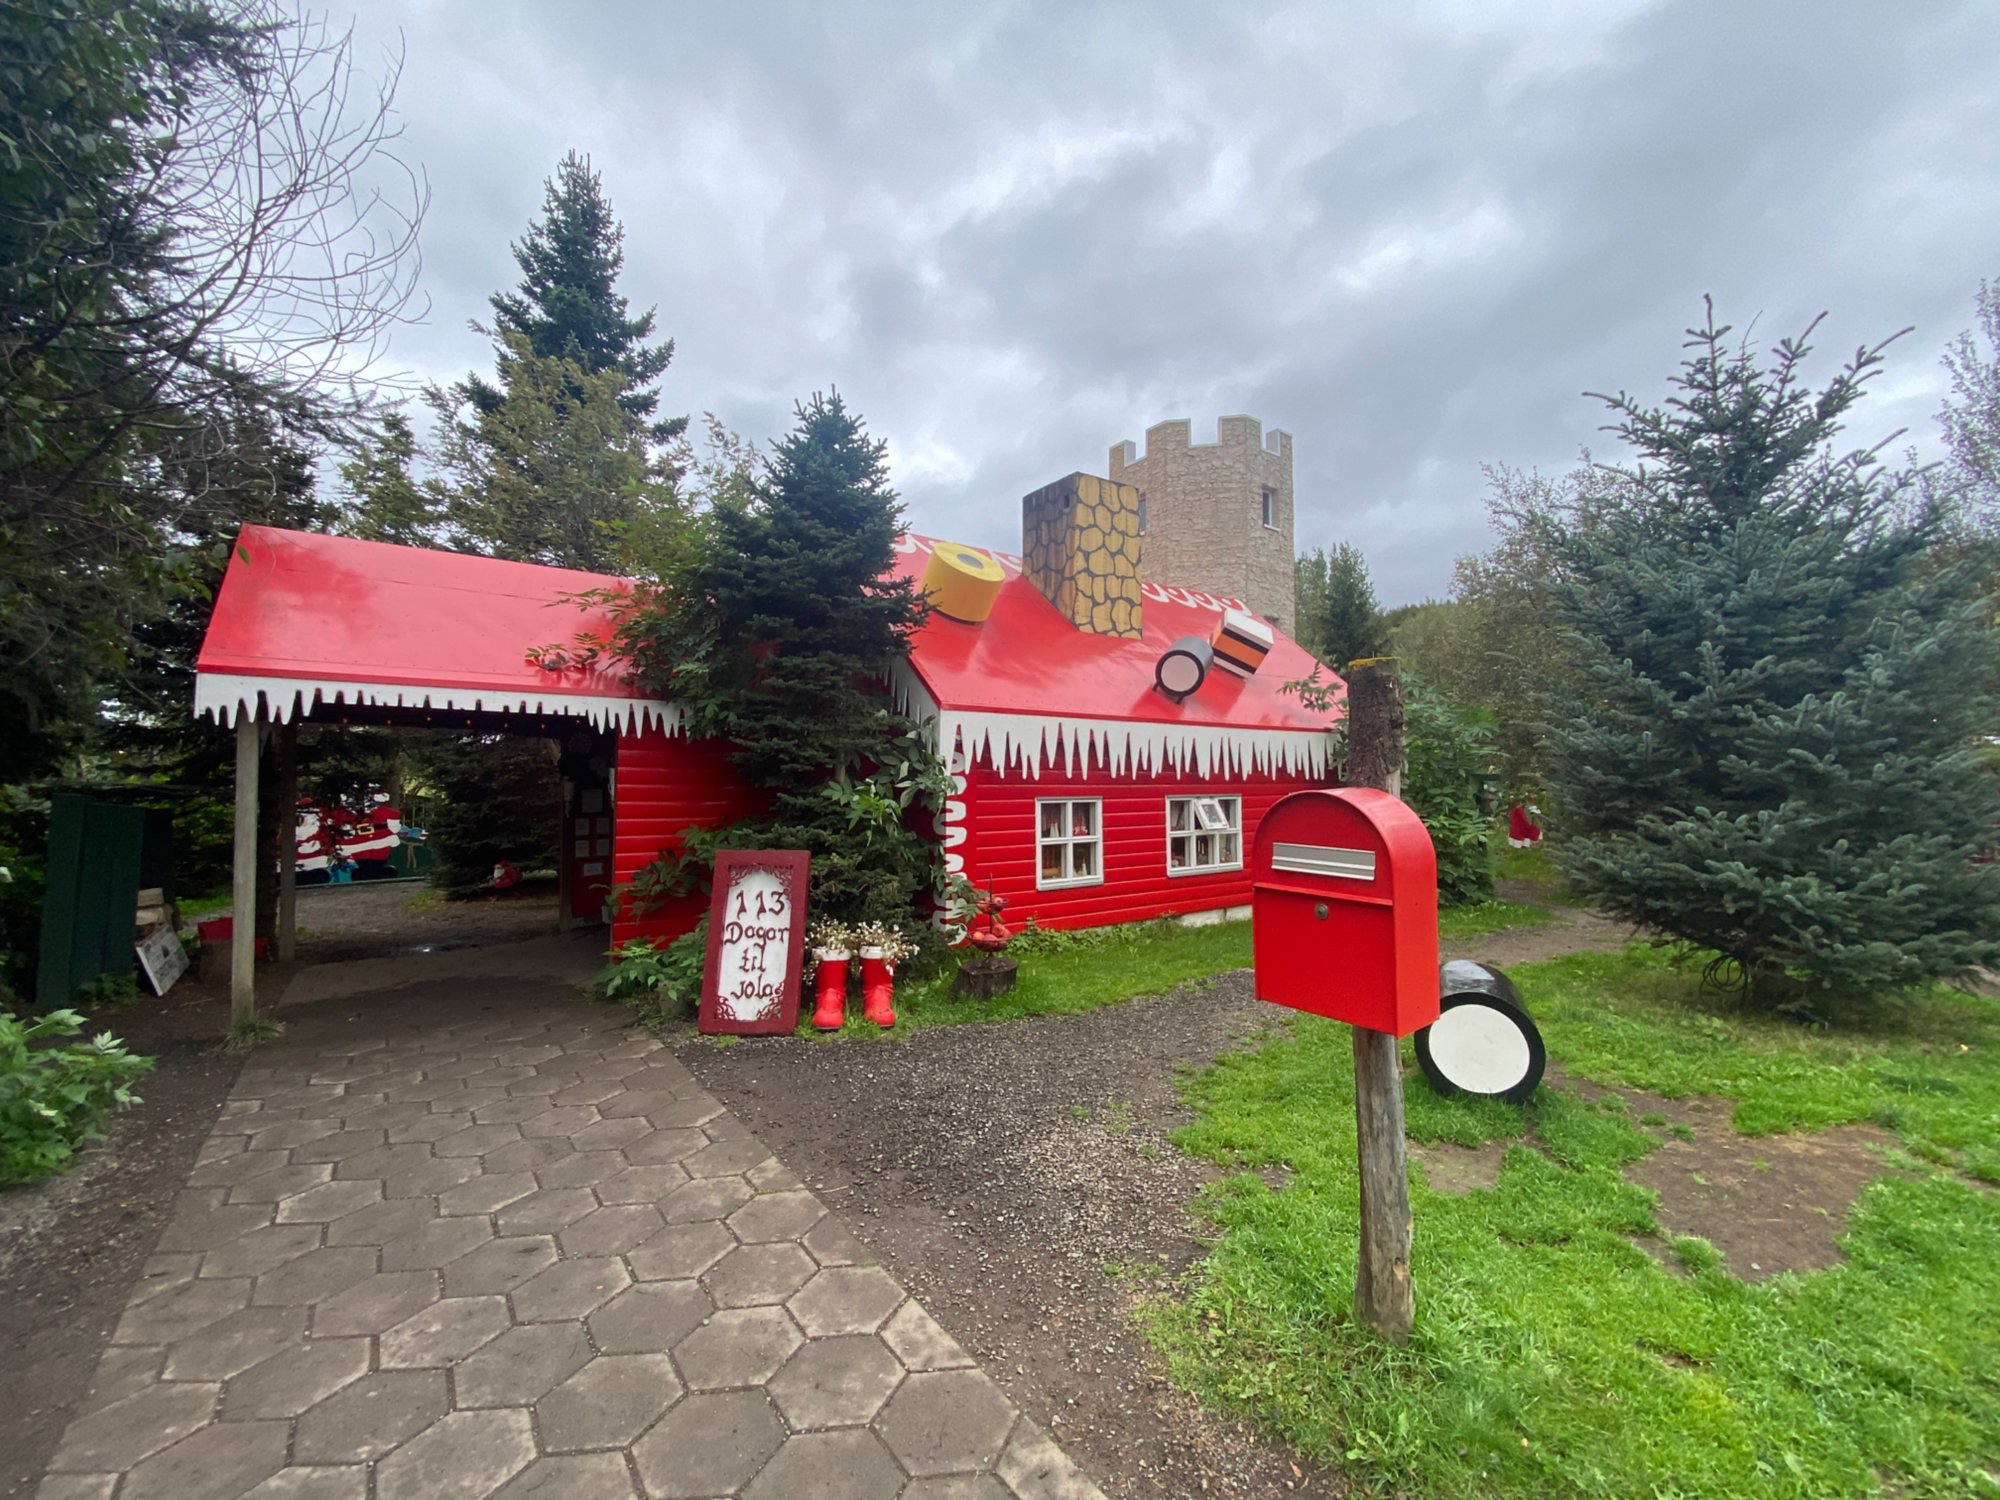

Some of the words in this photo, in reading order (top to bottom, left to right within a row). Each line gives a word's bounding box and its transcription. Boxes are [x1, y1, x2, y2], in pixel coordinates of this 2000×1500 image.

[736, 890, 785, 920] 113
[724, 921, 790, 949] Dagar
[739, 946, 766, 973] til
